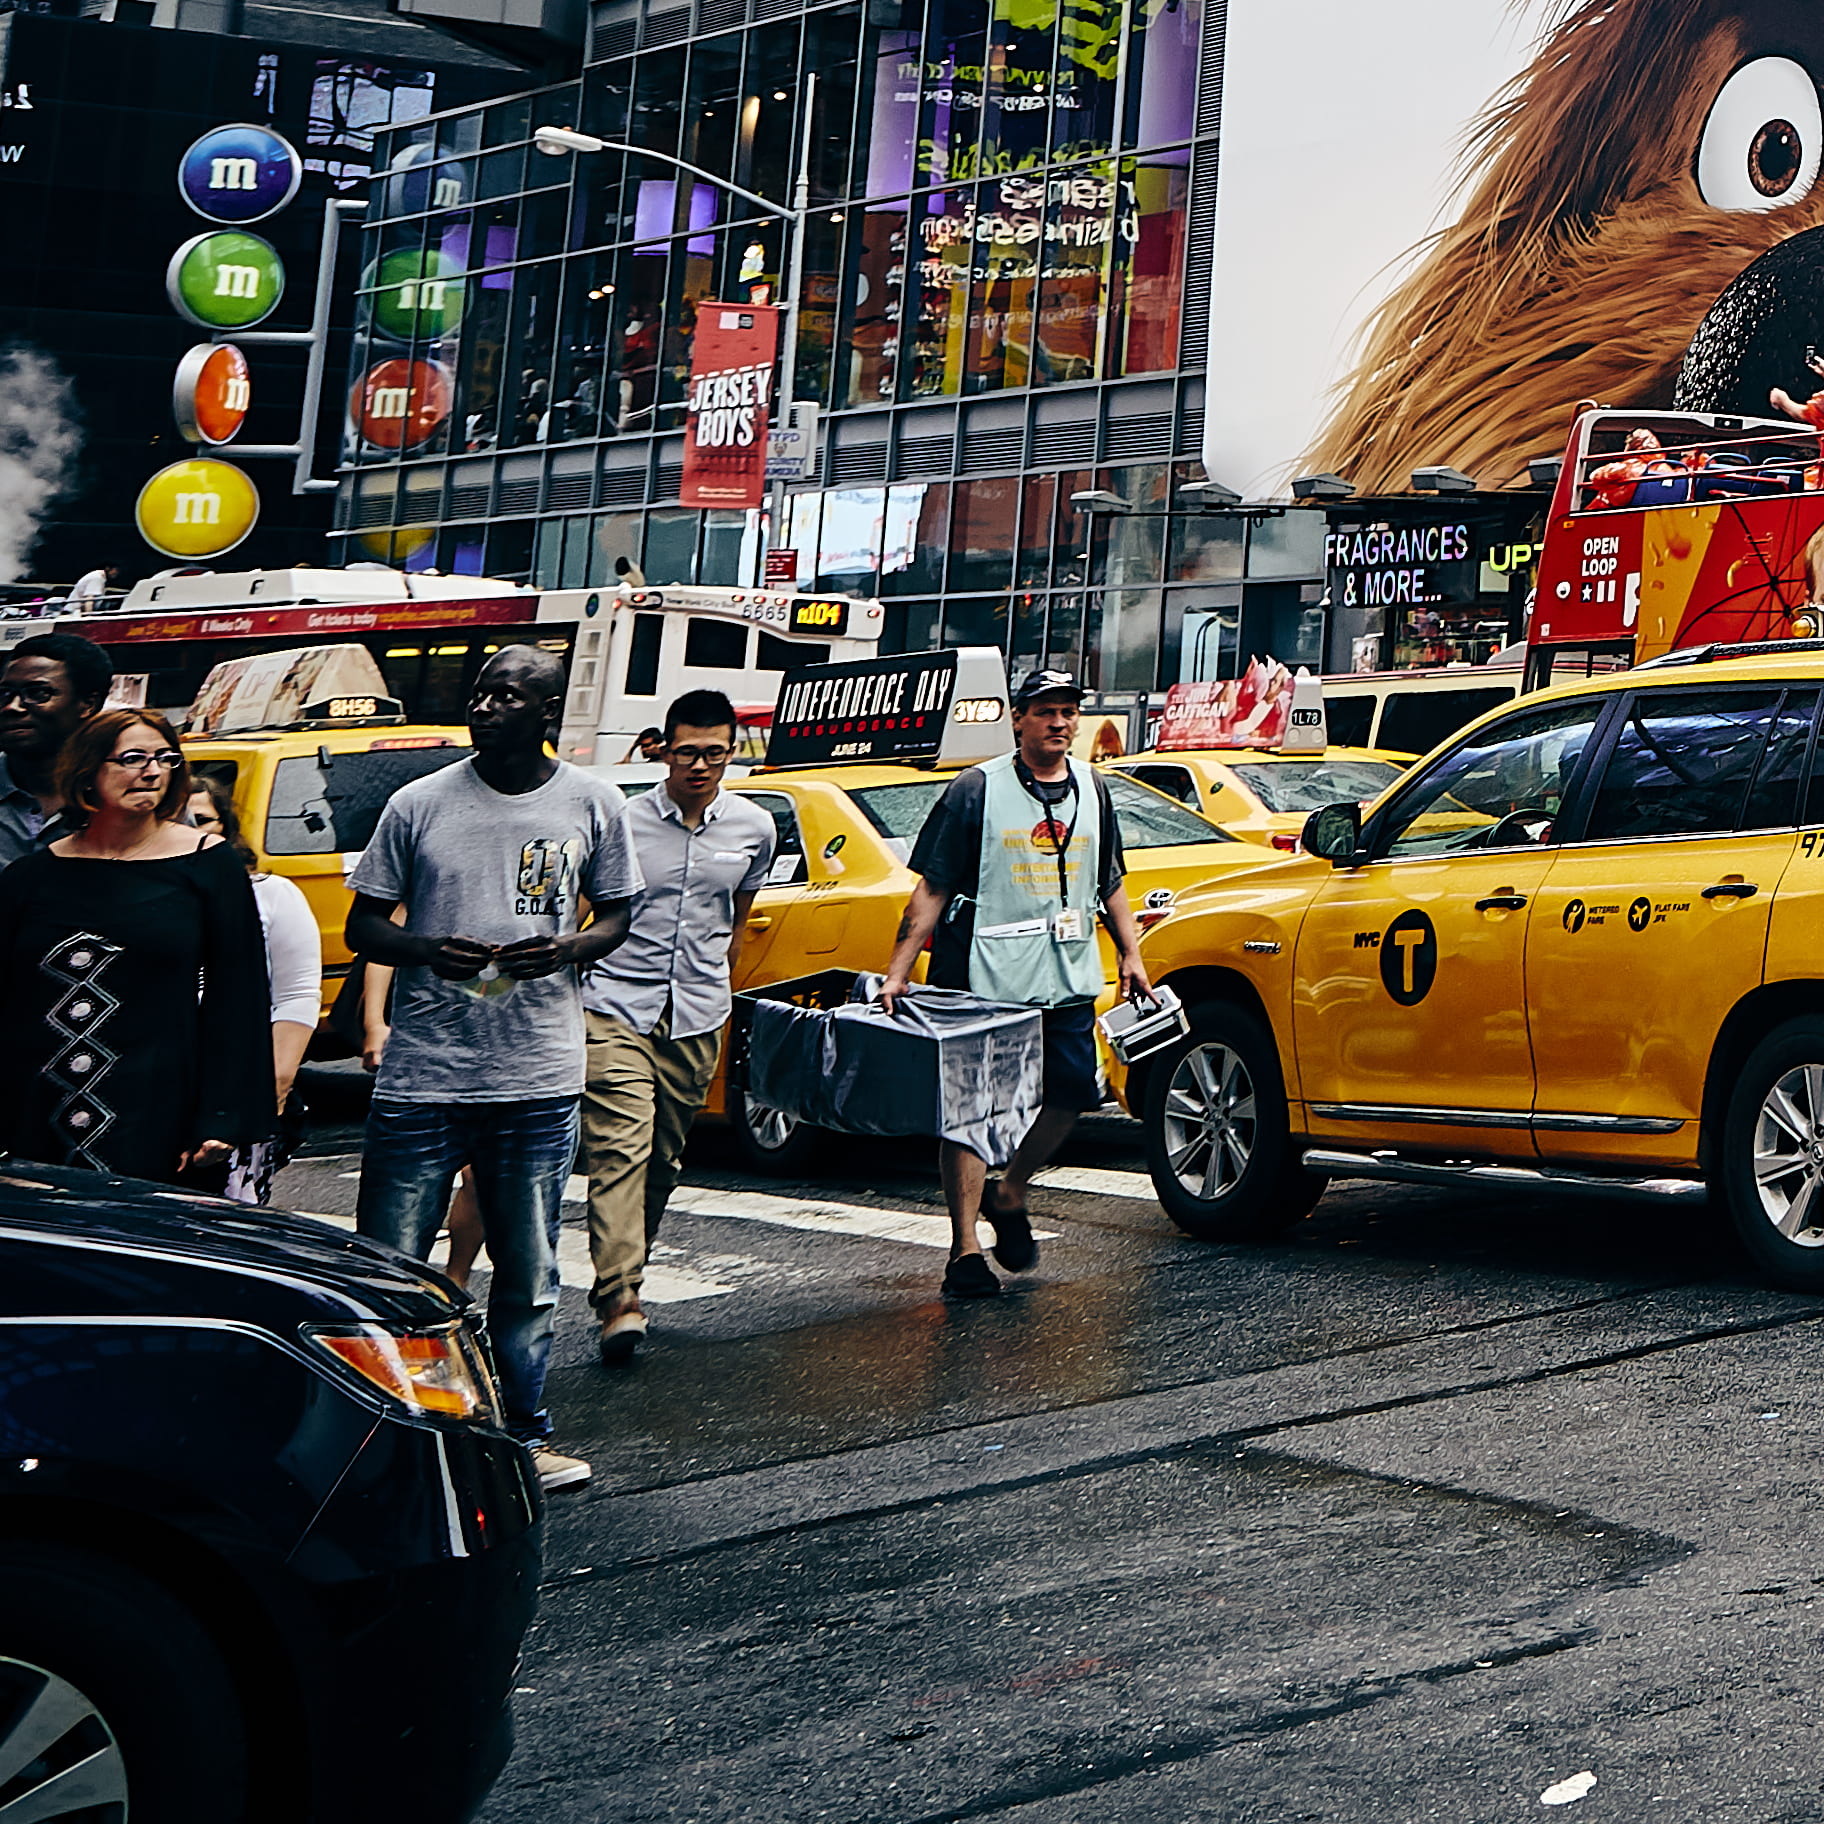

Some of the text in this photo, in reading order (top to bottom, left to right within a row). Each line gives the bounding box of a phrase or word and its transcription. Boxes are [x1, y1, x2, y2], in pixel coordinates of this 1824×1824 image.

[209, 157, 258, 190] m
[214, 264, 260, 299] m
[689, 367, 772, 412] JERSEY
[696, 405, 755, 448] BOYS
[173, 491, 221, 525] m
[1324, 524, 1468, 569] FRAGRANCES
[1583, 536, 1620, 557] OPEN
[1581, 557, 1618, 578] LOOP
[1343, 567, 1442, 607] & MORE...
[742, 603, 787, 621] 6665
[328, 698, 377, 717] 8H56
[778, 668, 952, 724] INDEPENDENCE DAY
[1292, 710, 1320, 726] 1L78
[1653, 902, 1691, 913] FLAT FARE
[1353, 931, 1381, 950] NYC
[1394, 928, 1426, 994] T
